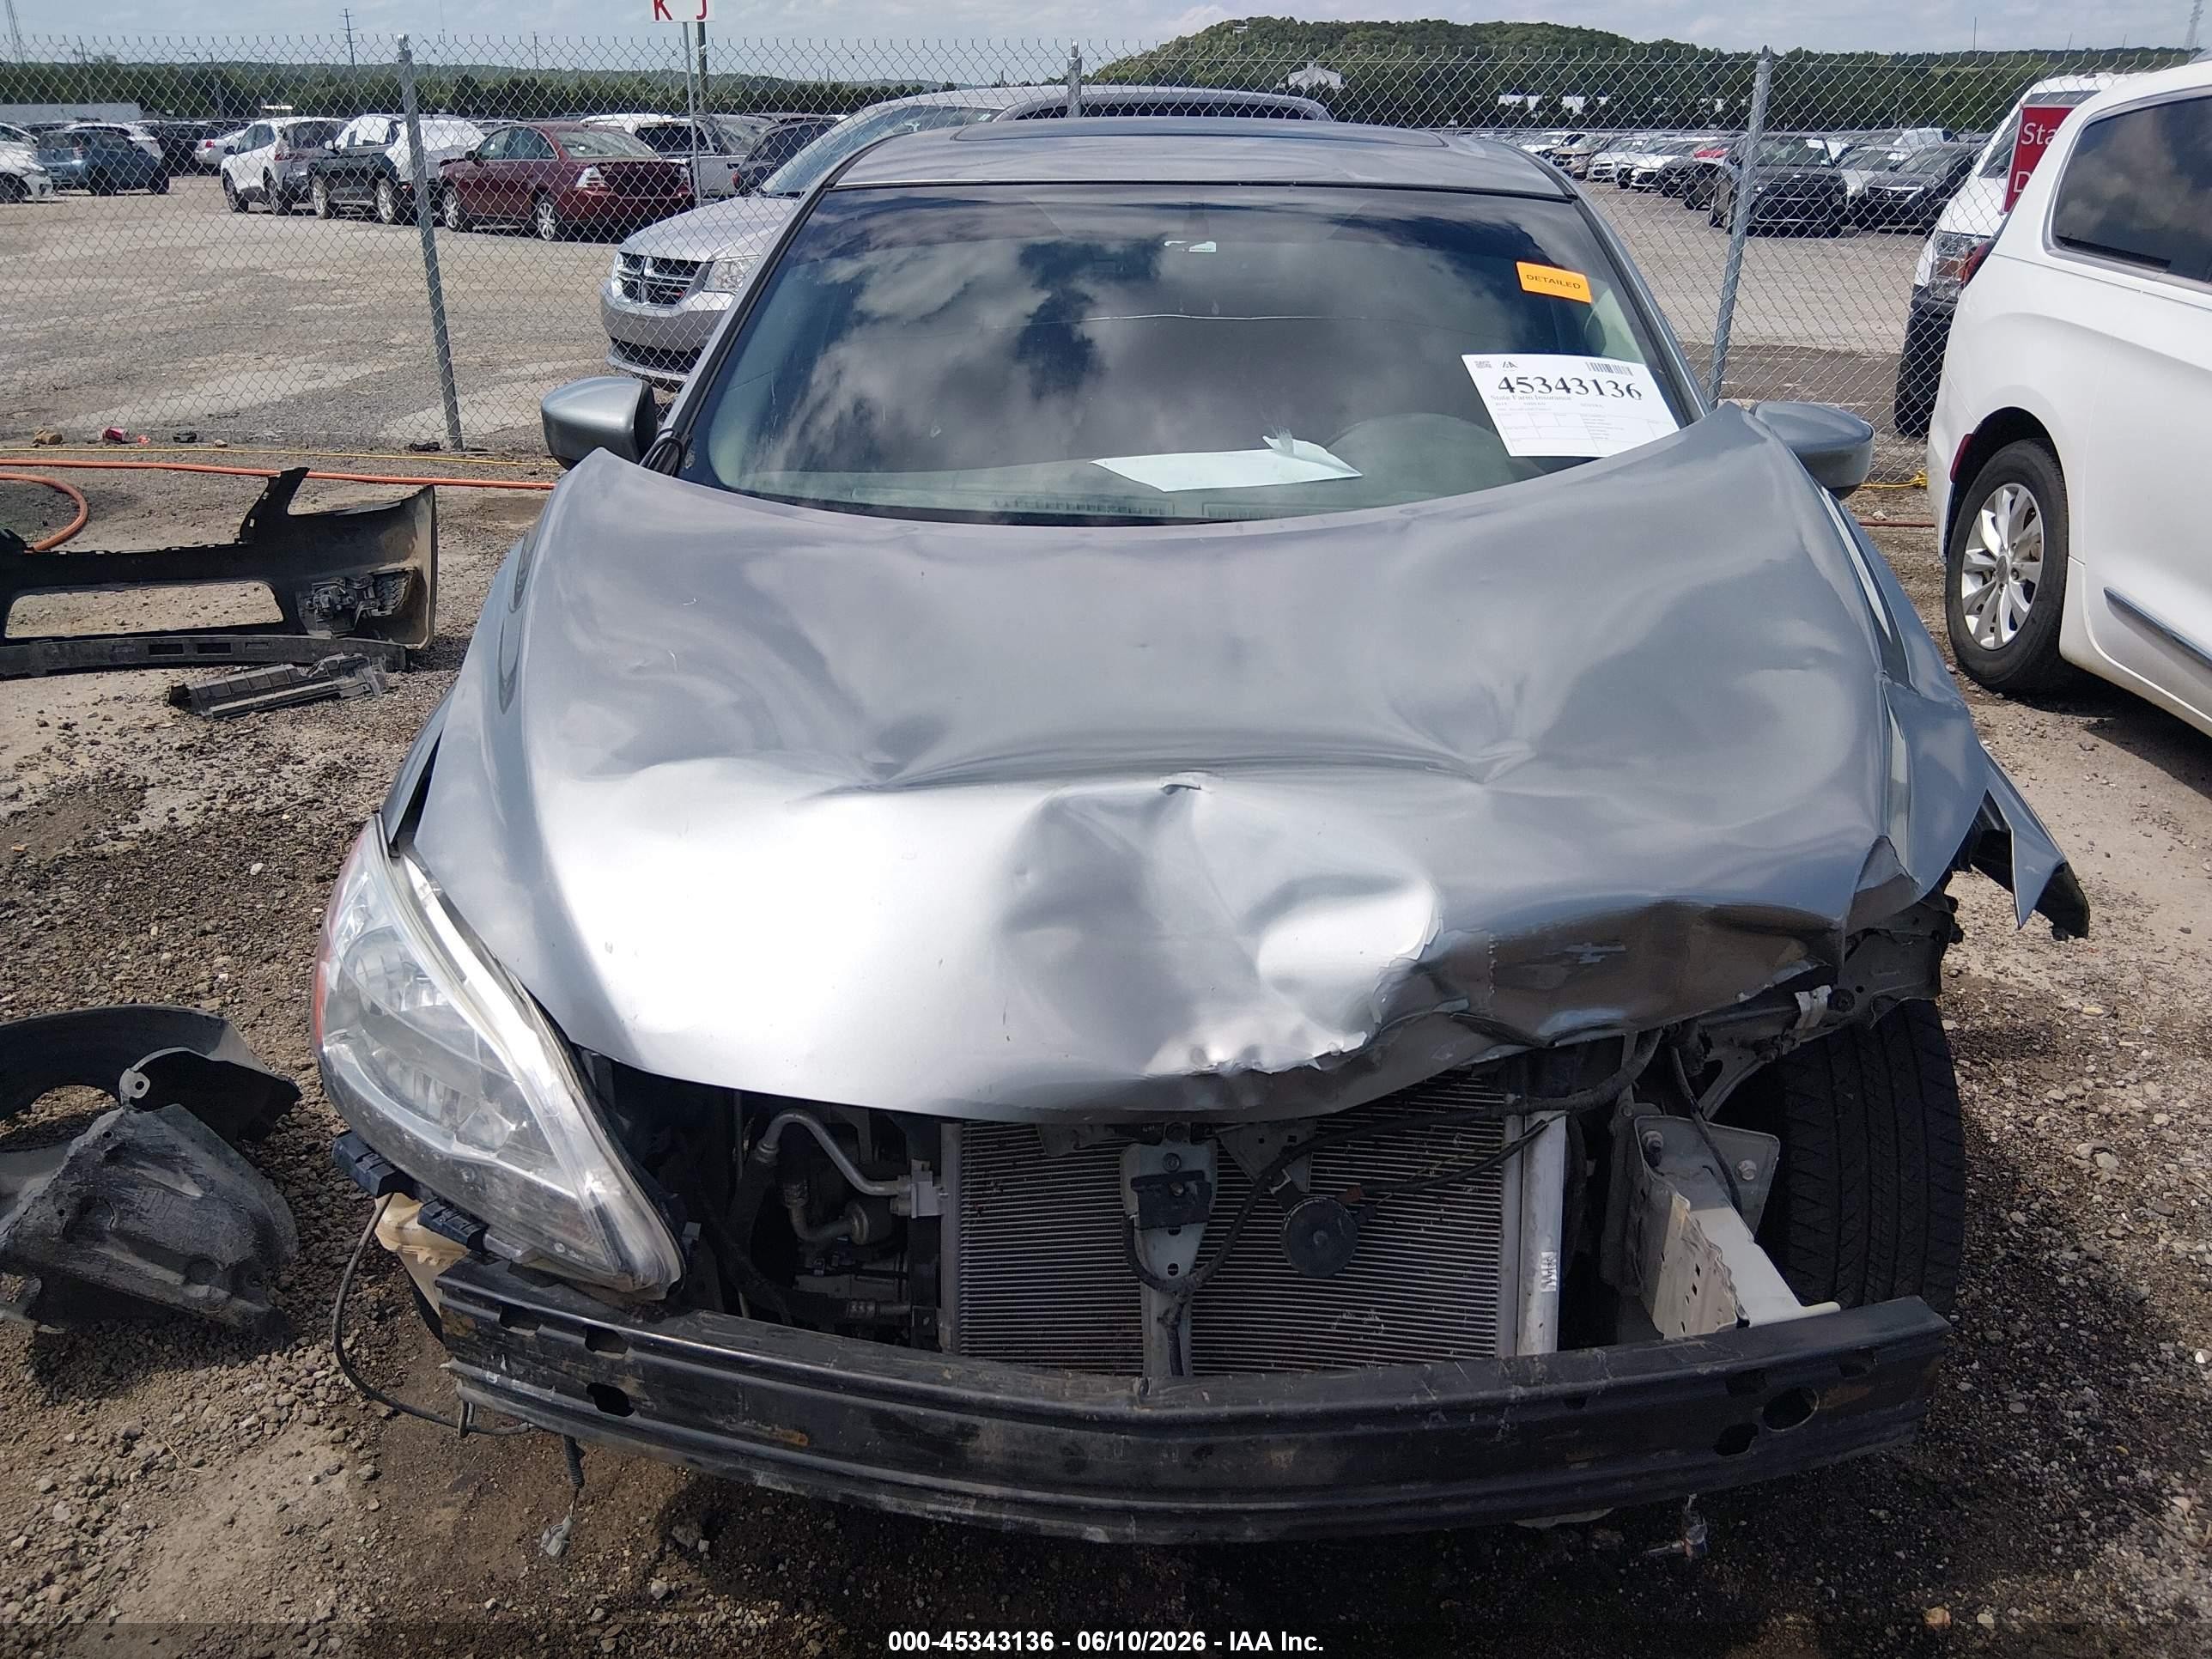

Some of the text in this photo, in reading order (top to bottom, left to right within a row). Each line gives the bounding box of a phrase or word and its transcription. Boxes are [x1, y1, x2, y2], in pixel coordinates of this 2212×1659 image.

[653, 0, 708, 21] K J
[1526, 274, 1581, 289] DETAILED
[1498, 376, 1642, 401] 45343136
